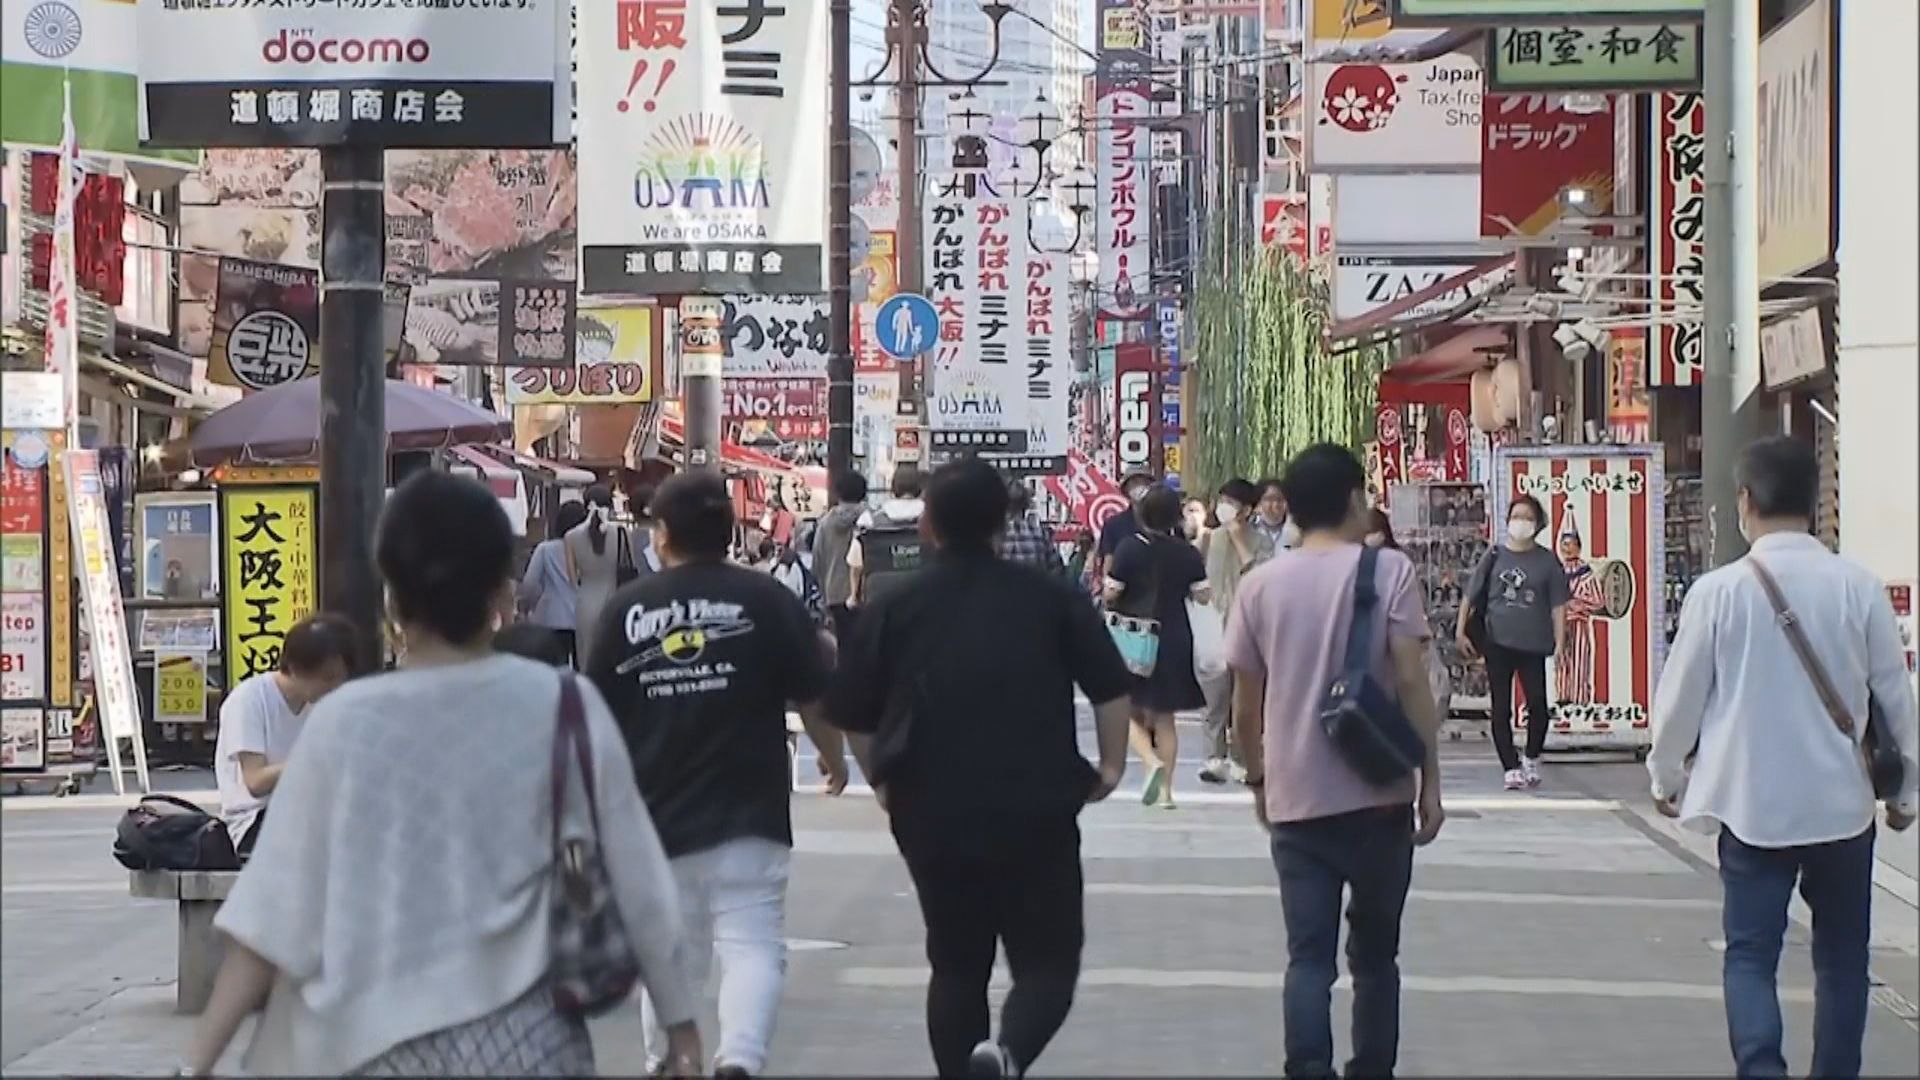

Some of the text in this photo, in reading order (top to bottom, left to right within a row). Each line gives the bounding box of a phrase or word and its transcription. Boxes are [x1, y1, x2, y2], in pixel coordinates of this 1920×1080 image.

[263, 29, 430, 63] docomo
[230, 89, 465, 124] 道頓堀商店会
[1488, 122, 1587, 149] ドラッグ
[643, 224, 768, 239] We are OSAKA
[977, 202, 1009, 364] がんばれミナミ
[1519, 473, 1643, 492] いらっしゃいませ
